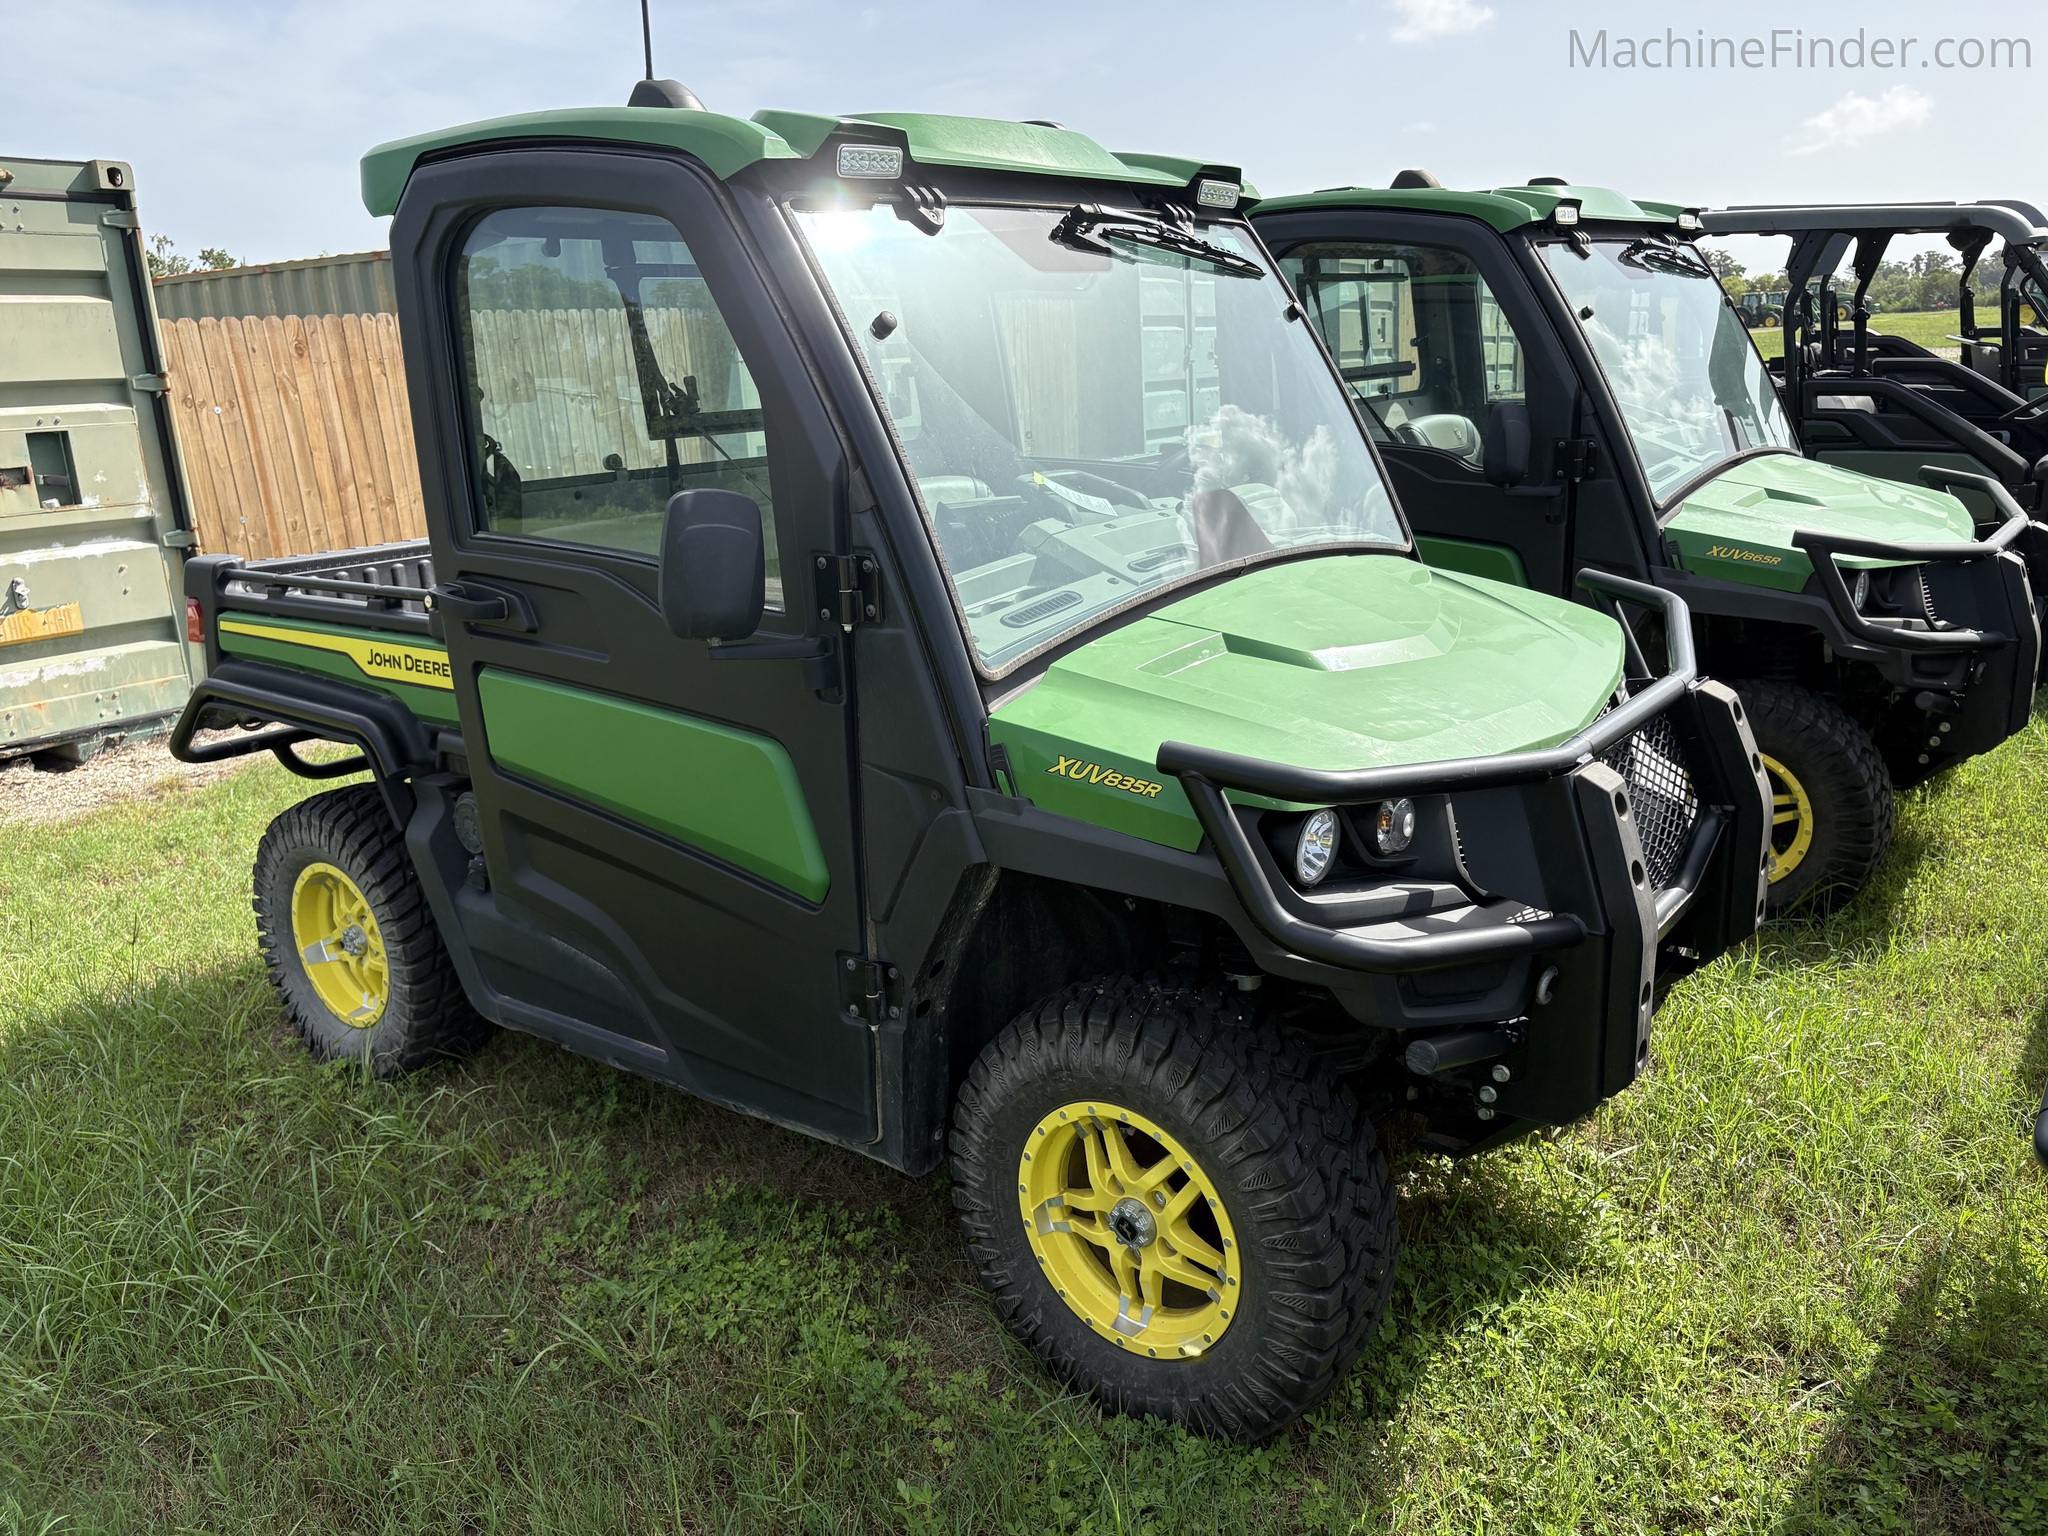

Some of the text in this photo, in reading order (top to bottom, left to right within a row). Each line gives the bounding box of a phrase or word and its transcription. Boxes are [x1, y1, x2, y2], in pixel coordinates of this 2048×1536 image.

[1705, 545, 1782, 565] XUV865R
[367, 648, 451, 678] JOHN DEERE
[1045, 754, 1163, 799] XUV835R
